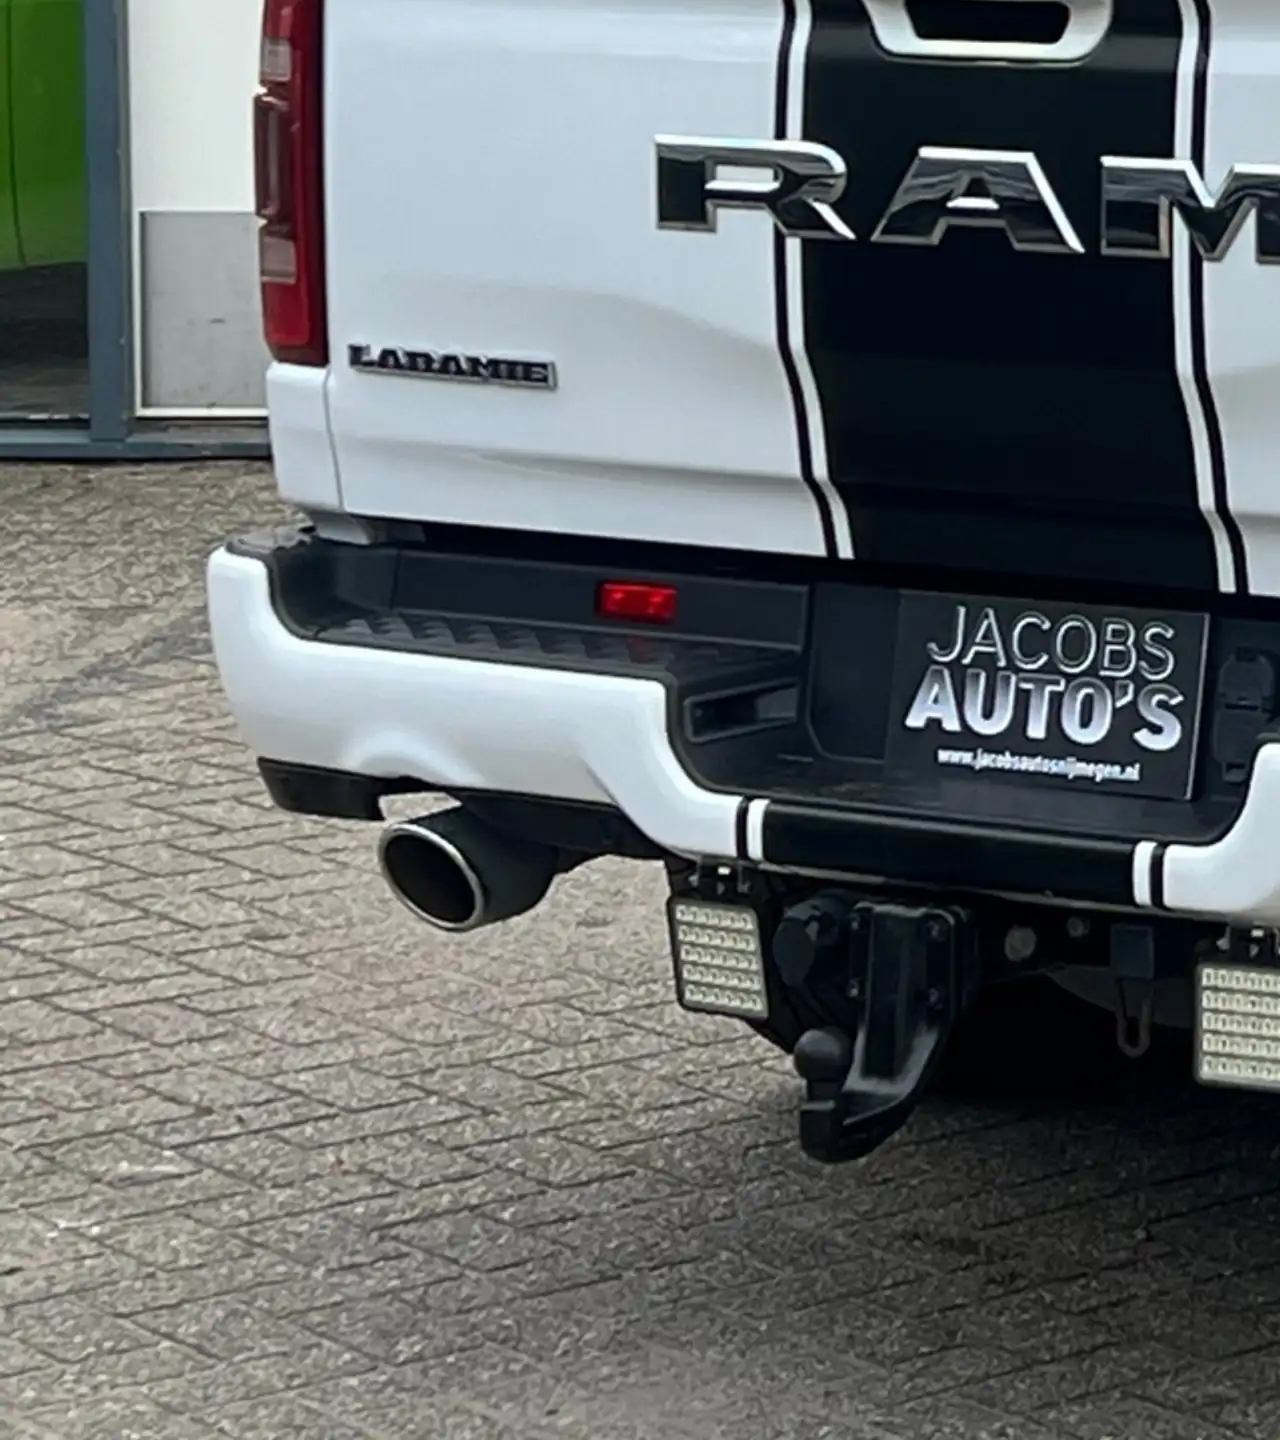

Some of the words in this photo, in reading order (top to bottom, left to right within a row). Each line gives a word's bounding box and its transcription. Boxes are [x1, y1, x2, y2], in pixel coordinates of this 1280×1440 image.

[348, 343, 558, 391] LARAMIE
[926, 605, 1176, 681] JACOBS
[904, 664, 1185, 751] AUTO'S
